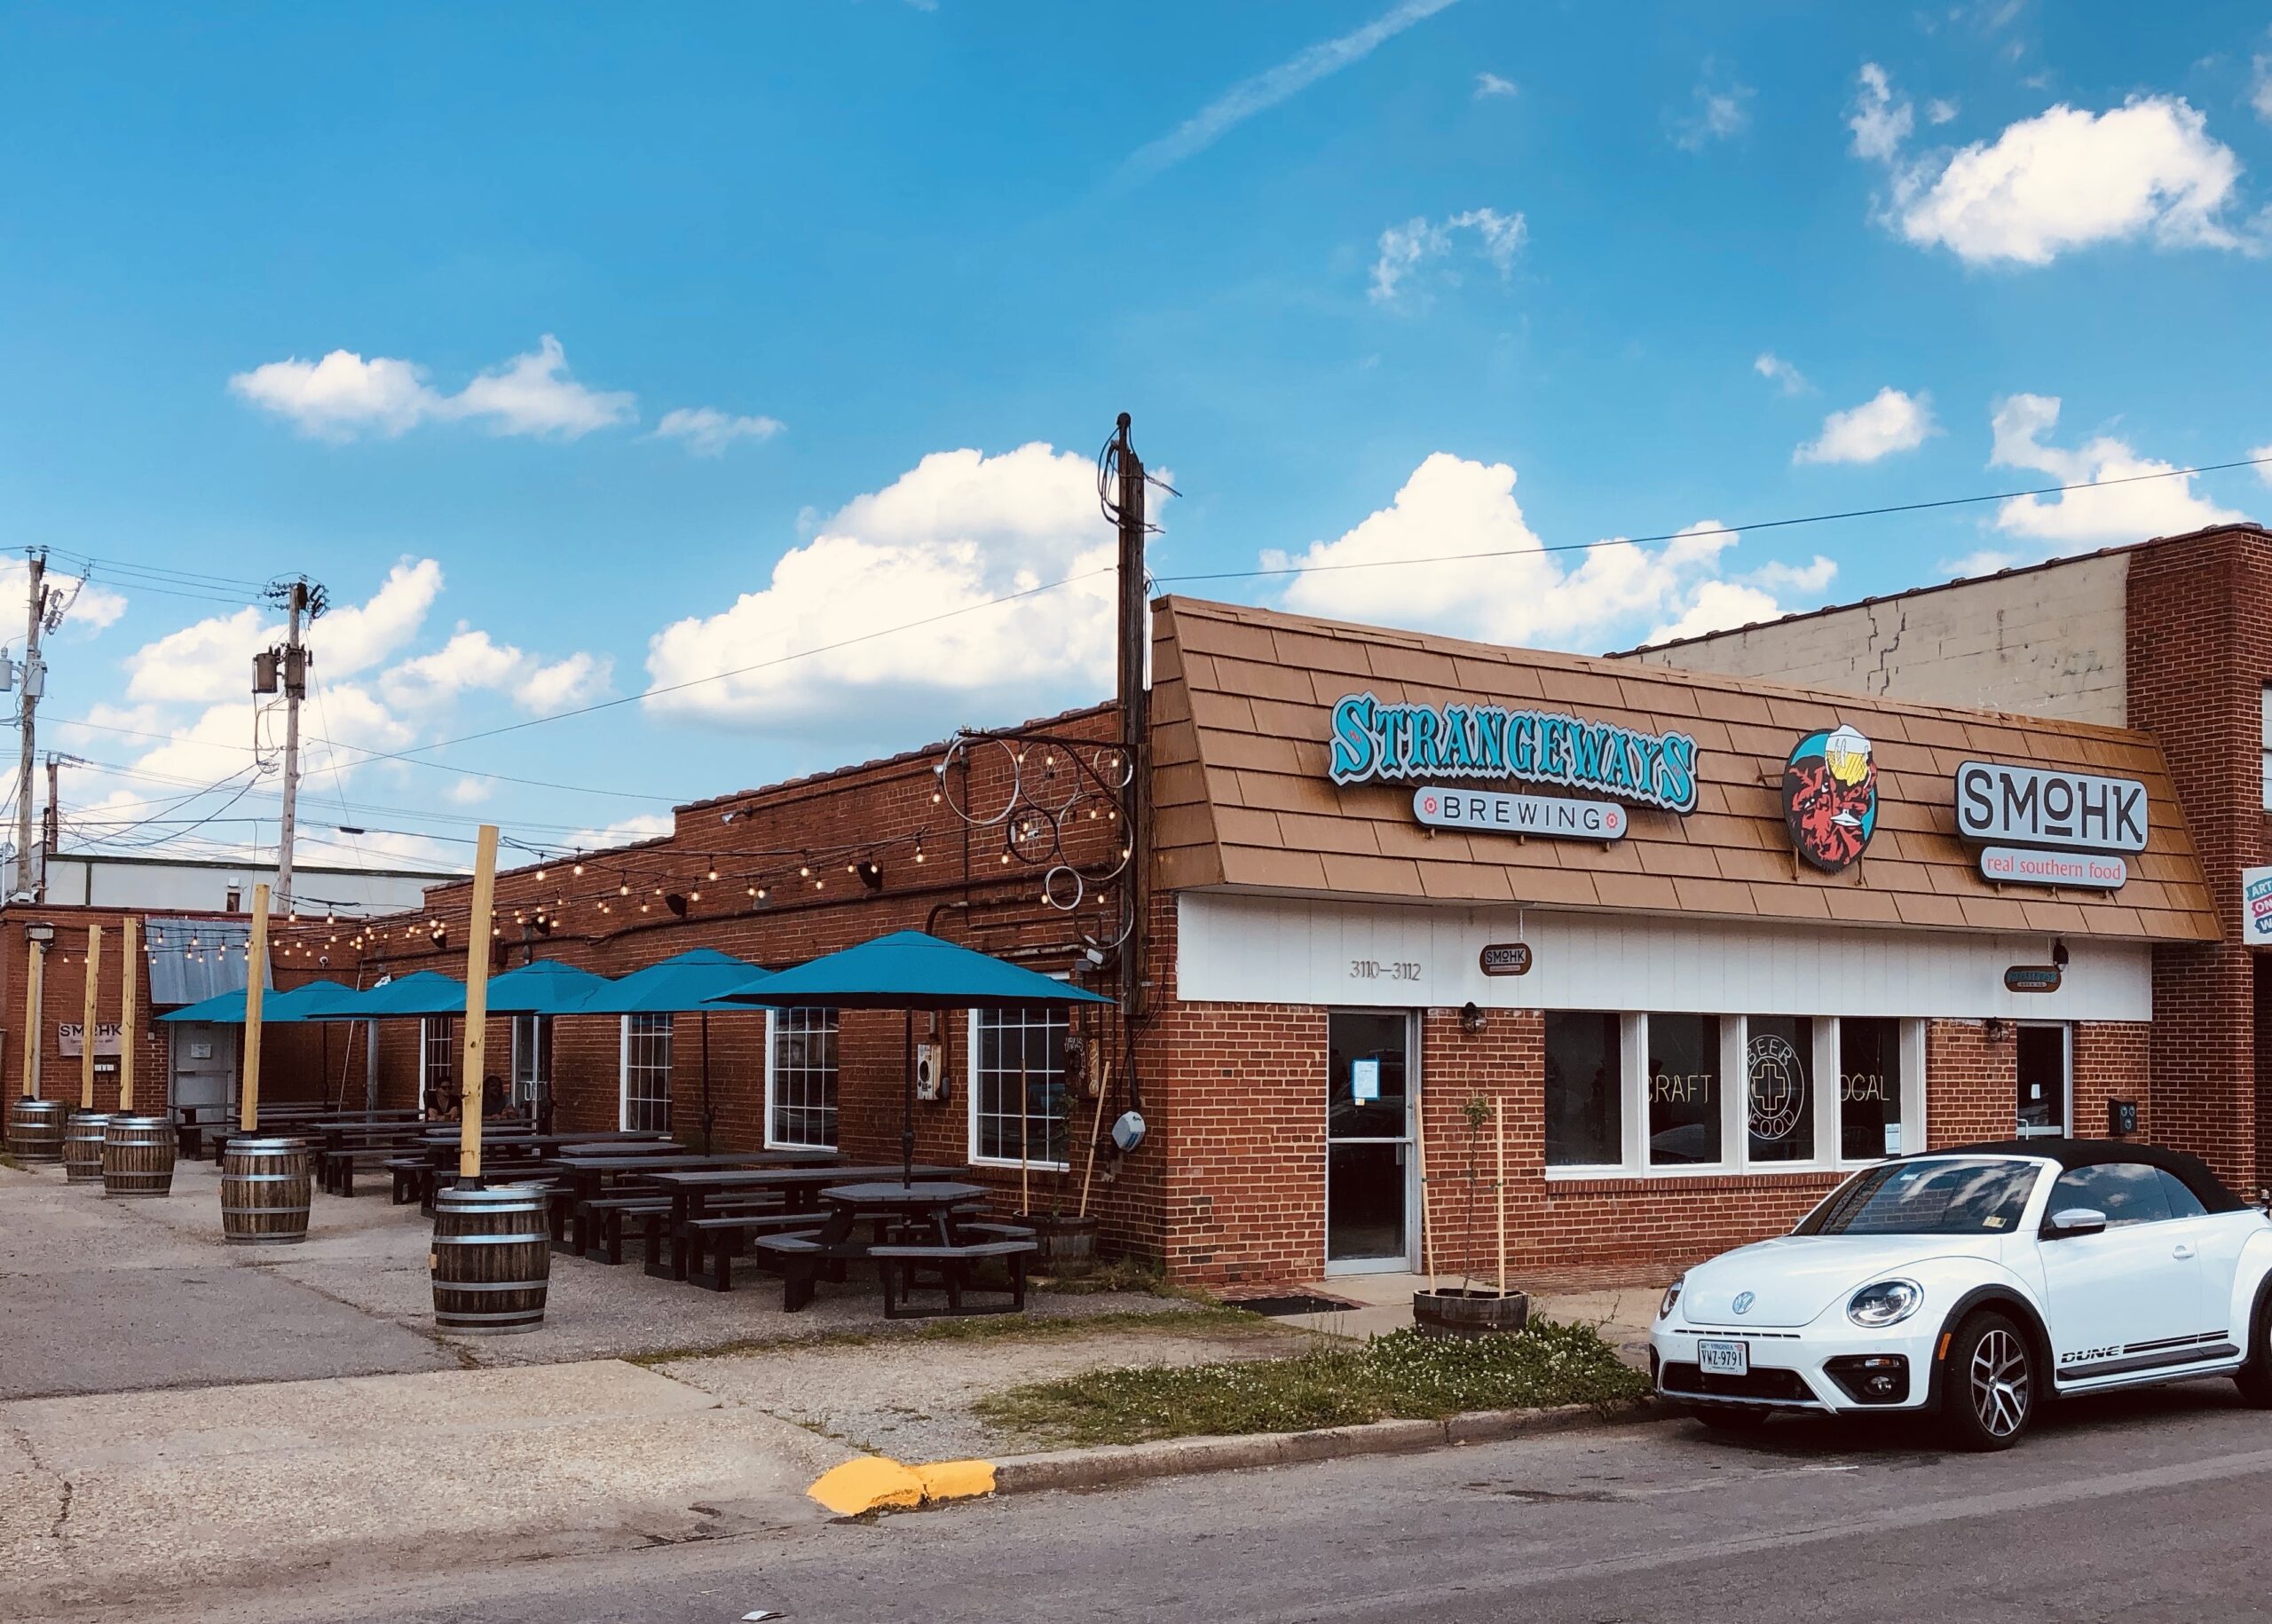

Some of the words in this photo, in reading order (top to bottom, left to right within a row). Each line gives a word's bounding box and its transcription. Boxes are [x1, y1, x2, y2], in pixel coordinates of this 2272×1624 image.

[1332, 695, 1695, 807] STRANGEWAYS
[1443, 795, 1601, 832] BREWING
[1964, 769, 2143, 844] SMOHK
[1987, 856, 2014, 872] real
[2019, 859, 2083, 878] southern
[2088, 862, 2121, 880] food
[1486, 950, 1525, 963] SMOHK
[1350, 960, 1421, 981] 3110-3112
[59, 1024, 122, 1037] SMHK
[1841, 1072, 1890, 1101] OCAL
[2061, 1345, 2120, 1364] DUNE
